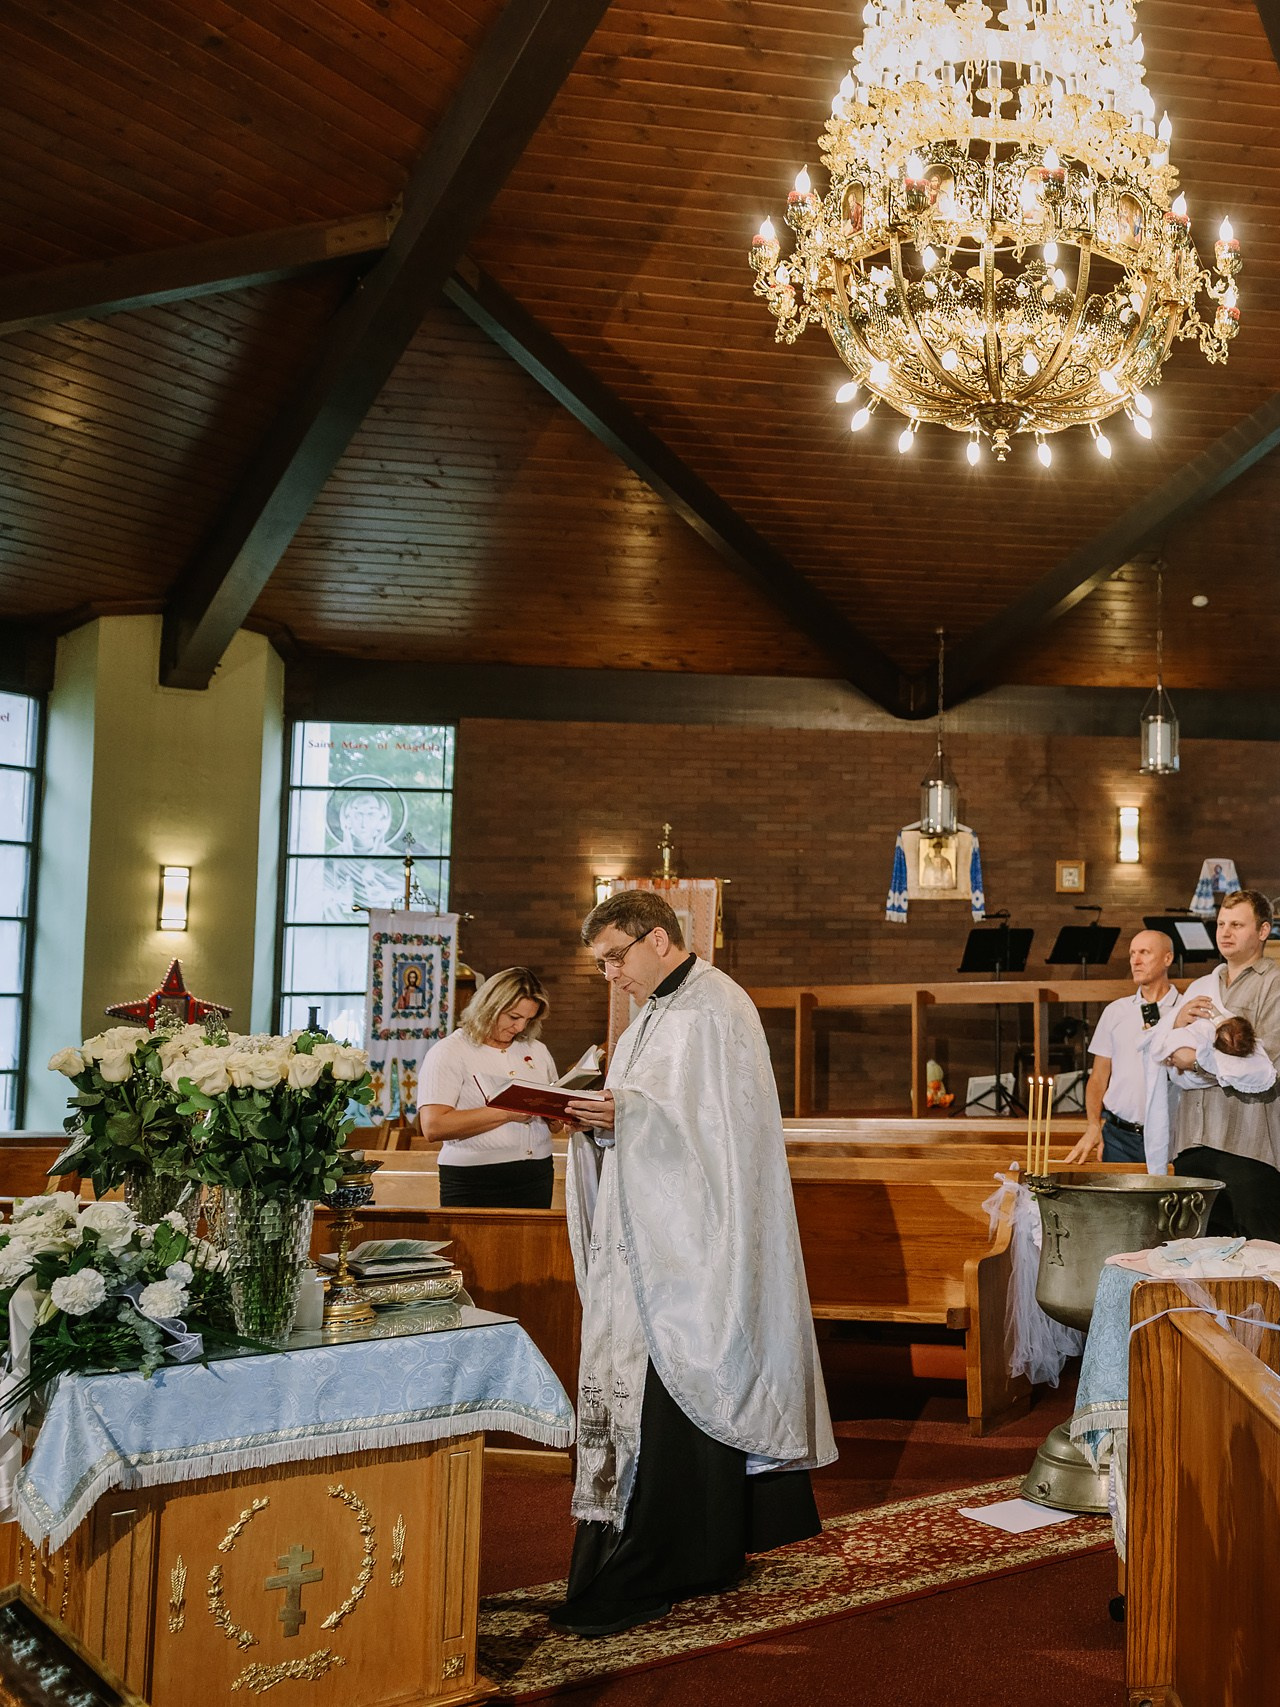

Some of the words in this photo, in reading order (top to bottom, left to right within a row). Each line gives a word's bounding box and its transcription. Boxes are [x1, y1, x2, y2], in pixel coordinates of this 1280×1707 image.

[308, 740, 335, 749] Saint
[342, 741, 369, 751] Mary
[377, 742, 388, 750] of
